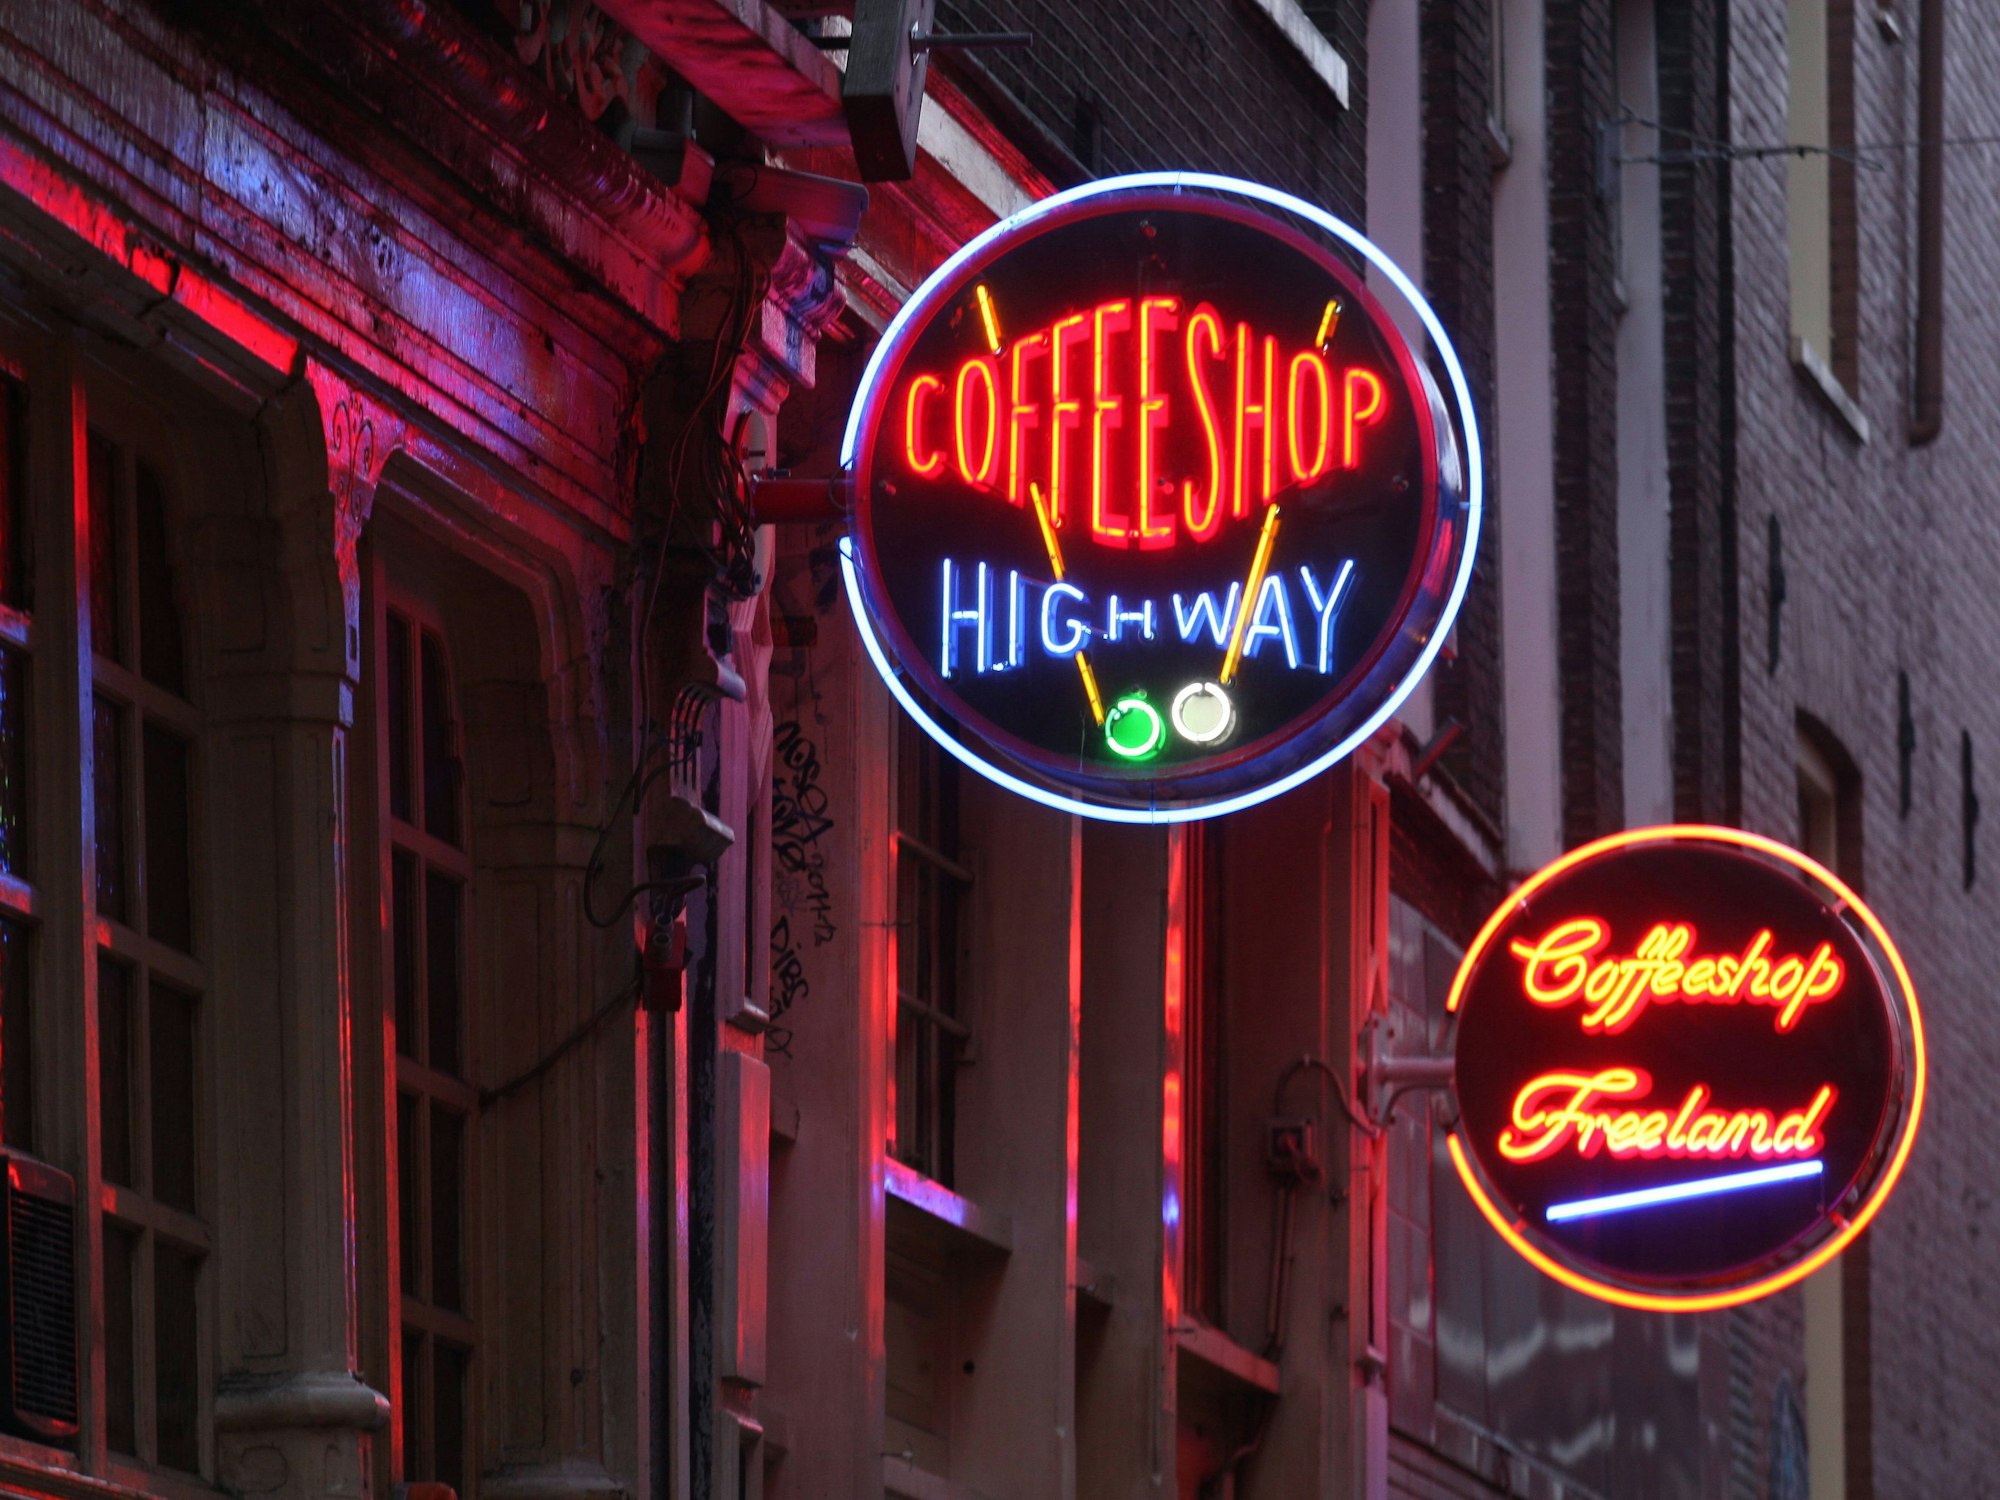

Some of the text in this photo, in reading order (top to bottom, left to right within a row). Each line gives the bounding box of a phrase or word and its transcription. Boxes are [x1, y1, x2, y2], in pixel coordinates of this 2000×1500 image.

[905, 297, 1387, 550] COFFEESHOP
[941, 557, 1356, 679] HIGHWAY
[1510, 914, 1845, 1033] Coffeeshop
[1498, 1066, 1838, 1163] Freeland
